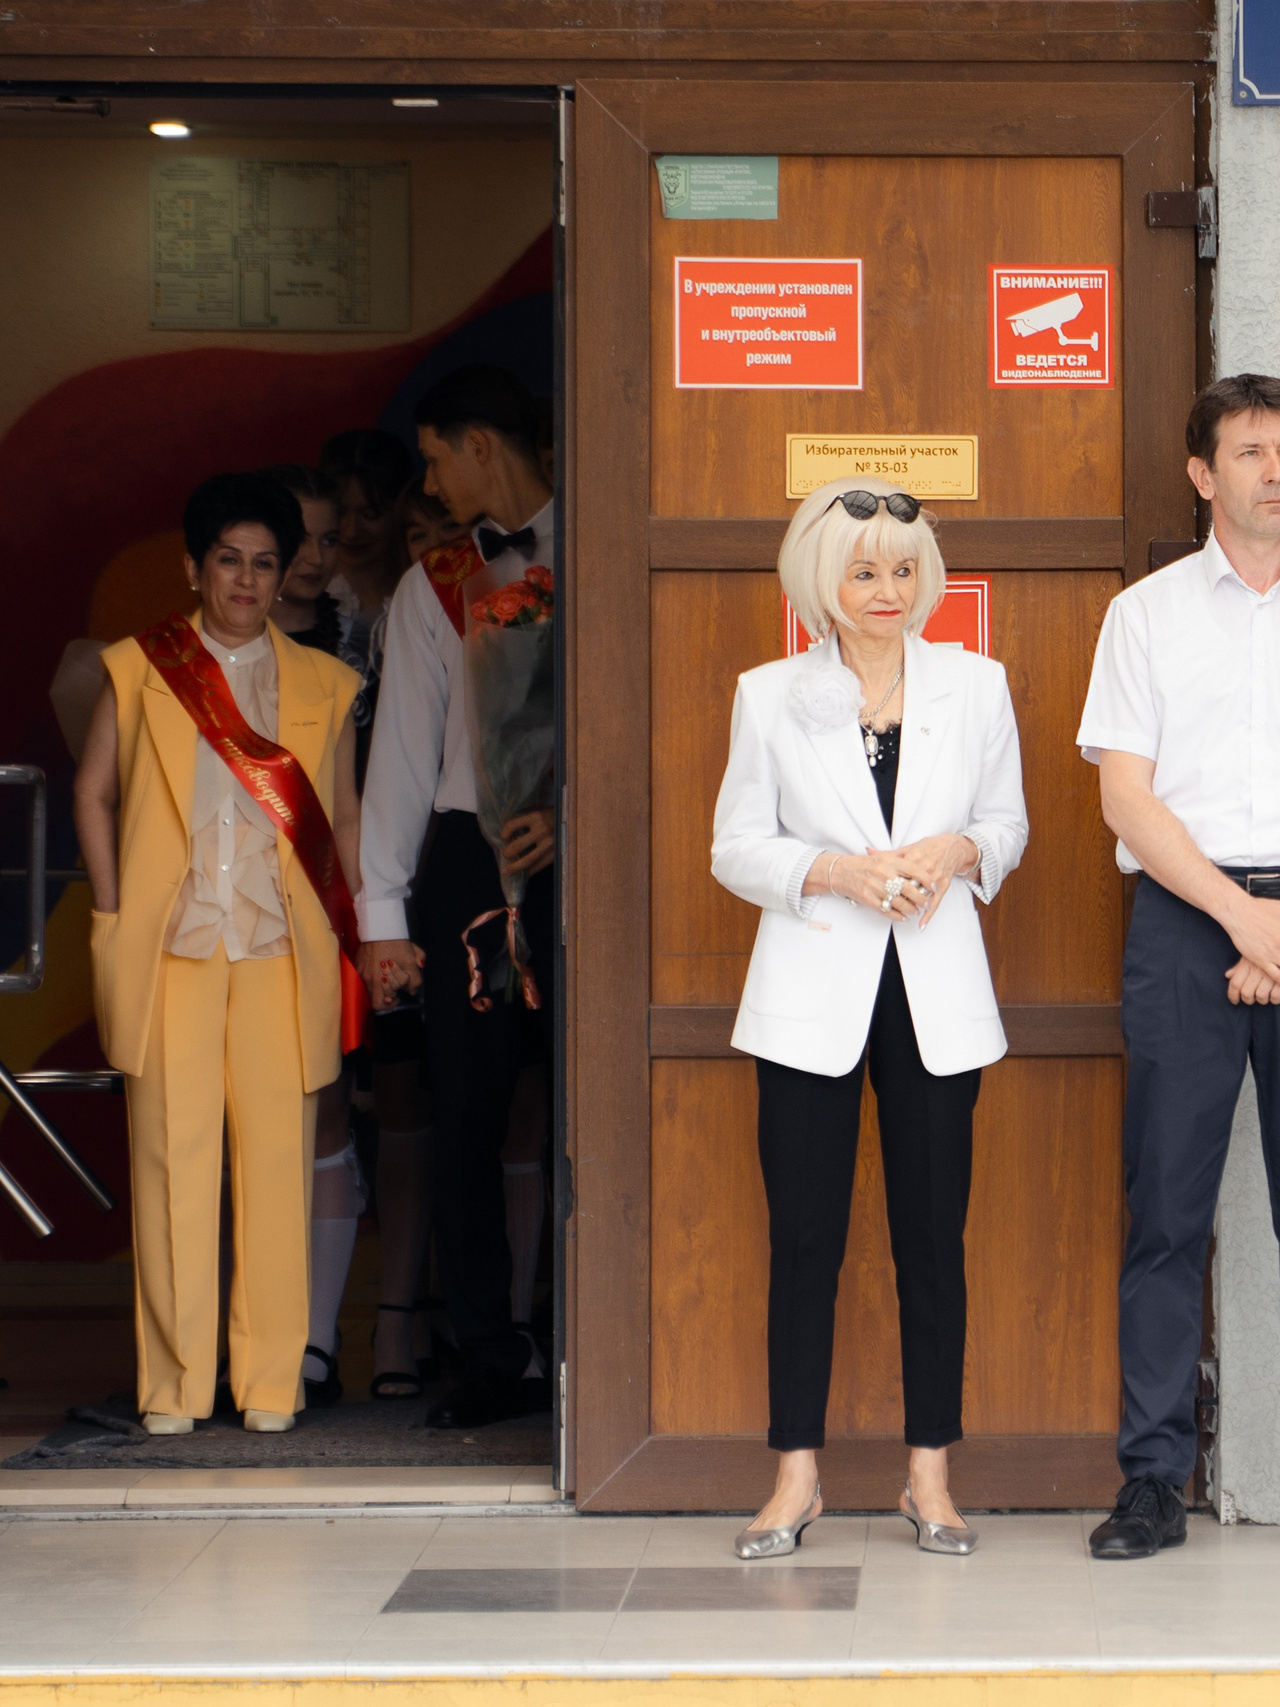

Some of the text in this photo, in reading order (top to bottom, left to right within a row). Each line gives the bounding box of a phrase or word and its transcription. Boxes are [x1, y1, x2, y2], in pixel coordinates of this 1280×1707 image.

[684, 279, 853, 297] В учреждении установлен
[1000, 276, 1103, 289] ВНИМАНИЕ!!!
[731, 304, 807, 320] пропускной
[701, 327, 837, 343] и внутреобъектовый
[746, 353, 792, 367] режим
[1016, 354, 1088, 368] ВЕДЕТСЯ
[1001, 369, 1102, 379] ВИДЕОНАБЛЮДЕНИЕ
[805, 444, 959, 459] Избирательный участок
[855, 462, 909, 474] № 35-03
